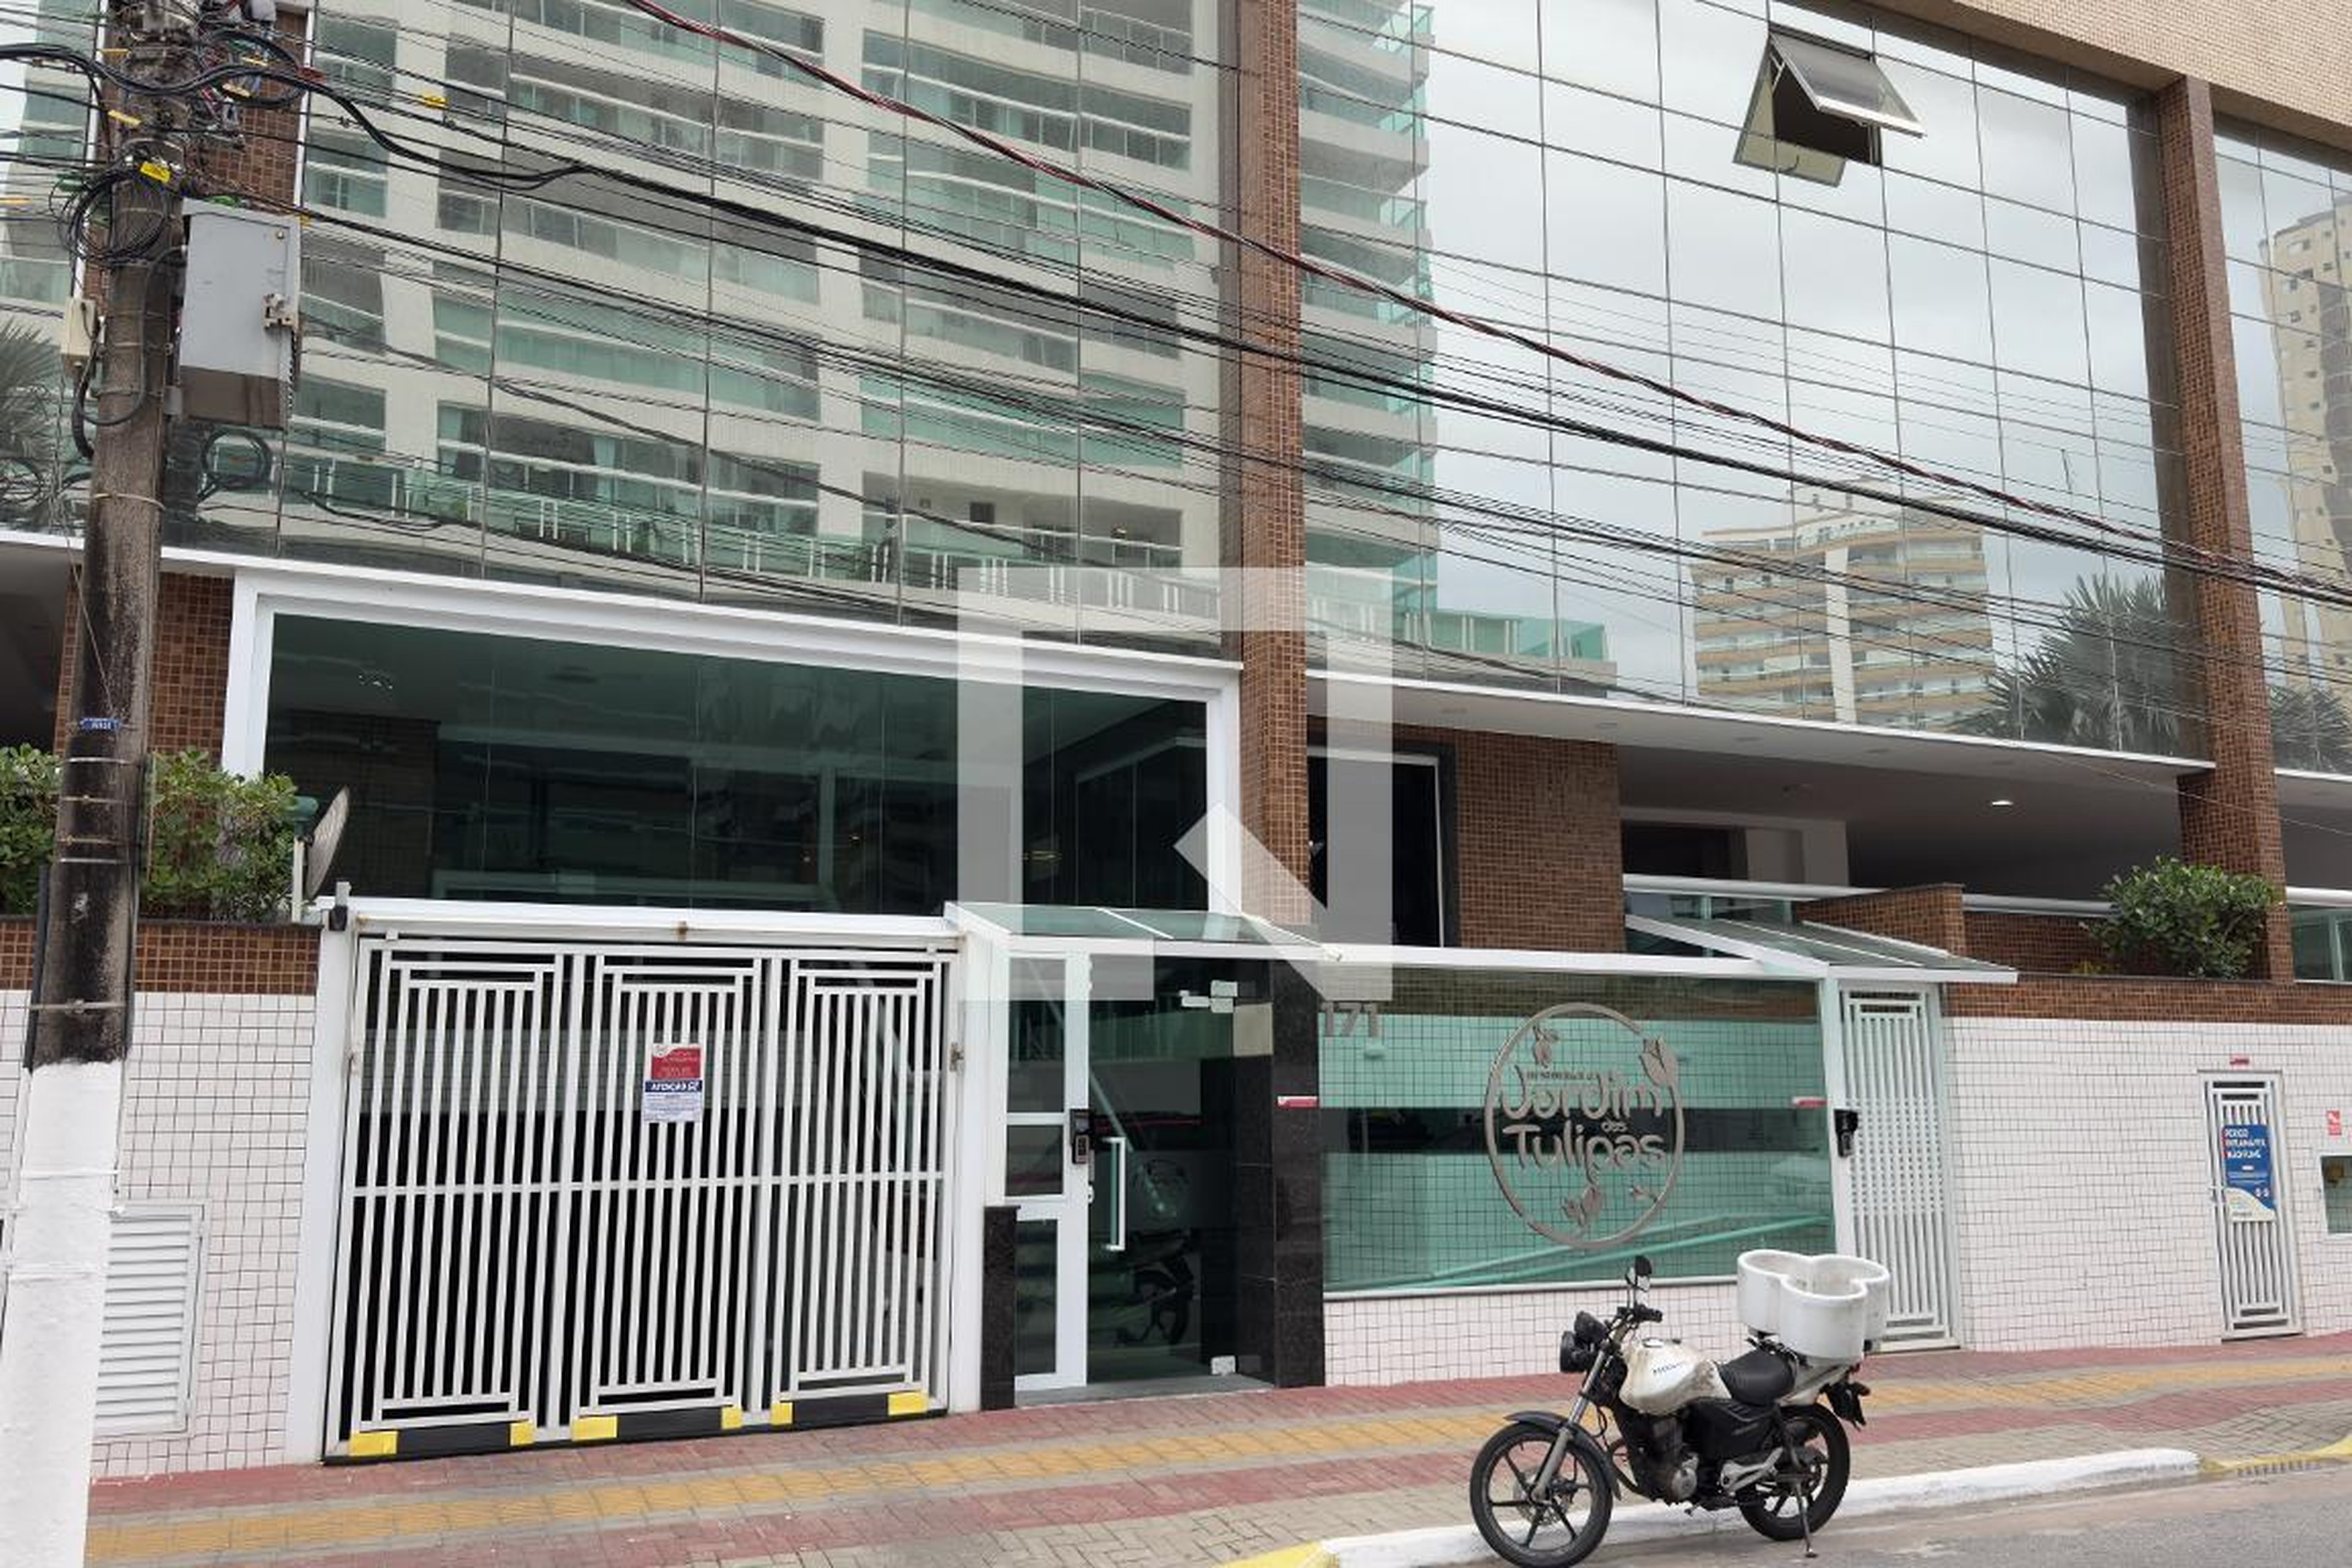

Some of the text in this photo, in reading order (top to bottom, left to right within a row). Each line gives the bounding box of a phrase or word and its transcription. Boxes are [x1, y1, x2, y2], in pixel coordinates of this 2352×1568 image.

[1321, 1002, 1378, 1038] 171
[1501, 1065, 1663, 1120] Jardim
[1502, 1120, 1667, 1184] Tulipas
